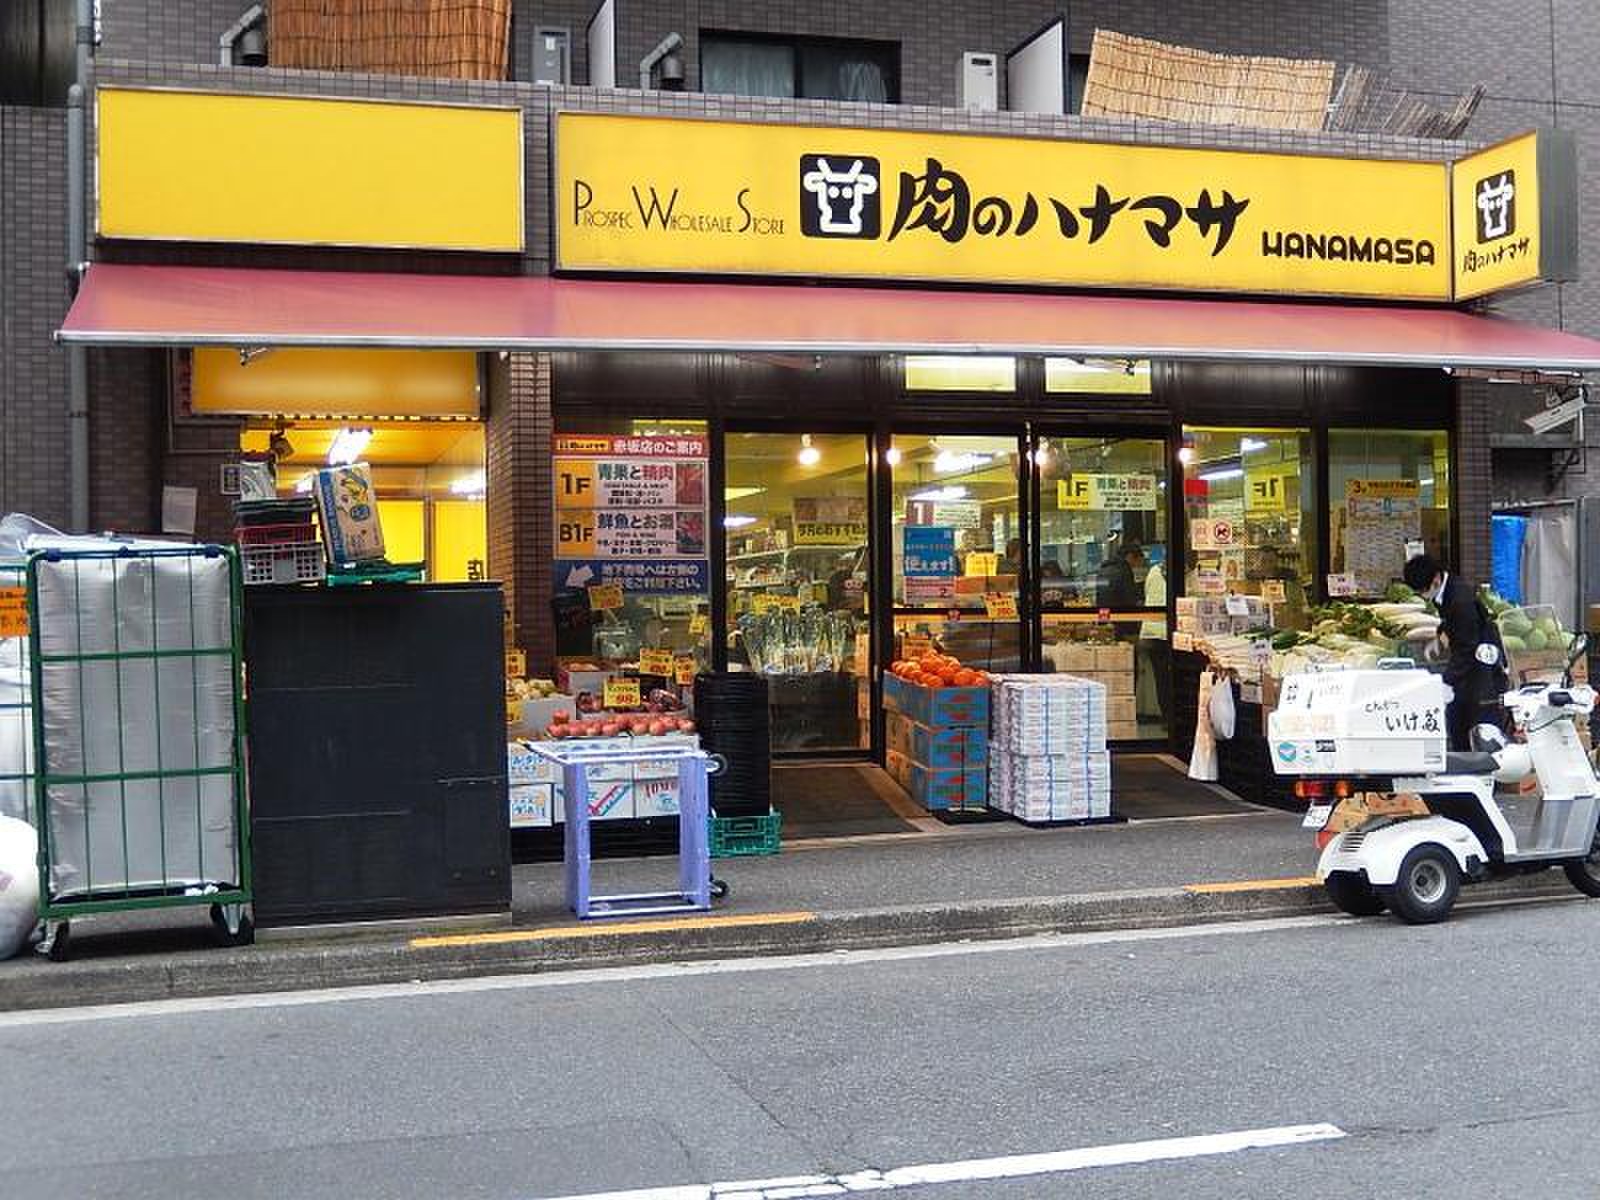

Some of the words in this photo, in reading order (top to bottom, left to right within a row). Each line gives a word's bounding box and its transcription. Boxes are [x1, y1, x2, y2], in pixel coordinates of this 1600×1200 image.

[632, 186, 733, 233] WHOLESALE
[737, 187, 785, 236] STORE
[887, 157, 1251, 258] 肉のハナマサ
[1261, 230, 1436, 267] HANAMASA
[1462, 235, 1531, 274] 肉のハナマサ
[561, 473, 591, 494] 1F
[560, 524, 593, 542] B1F
